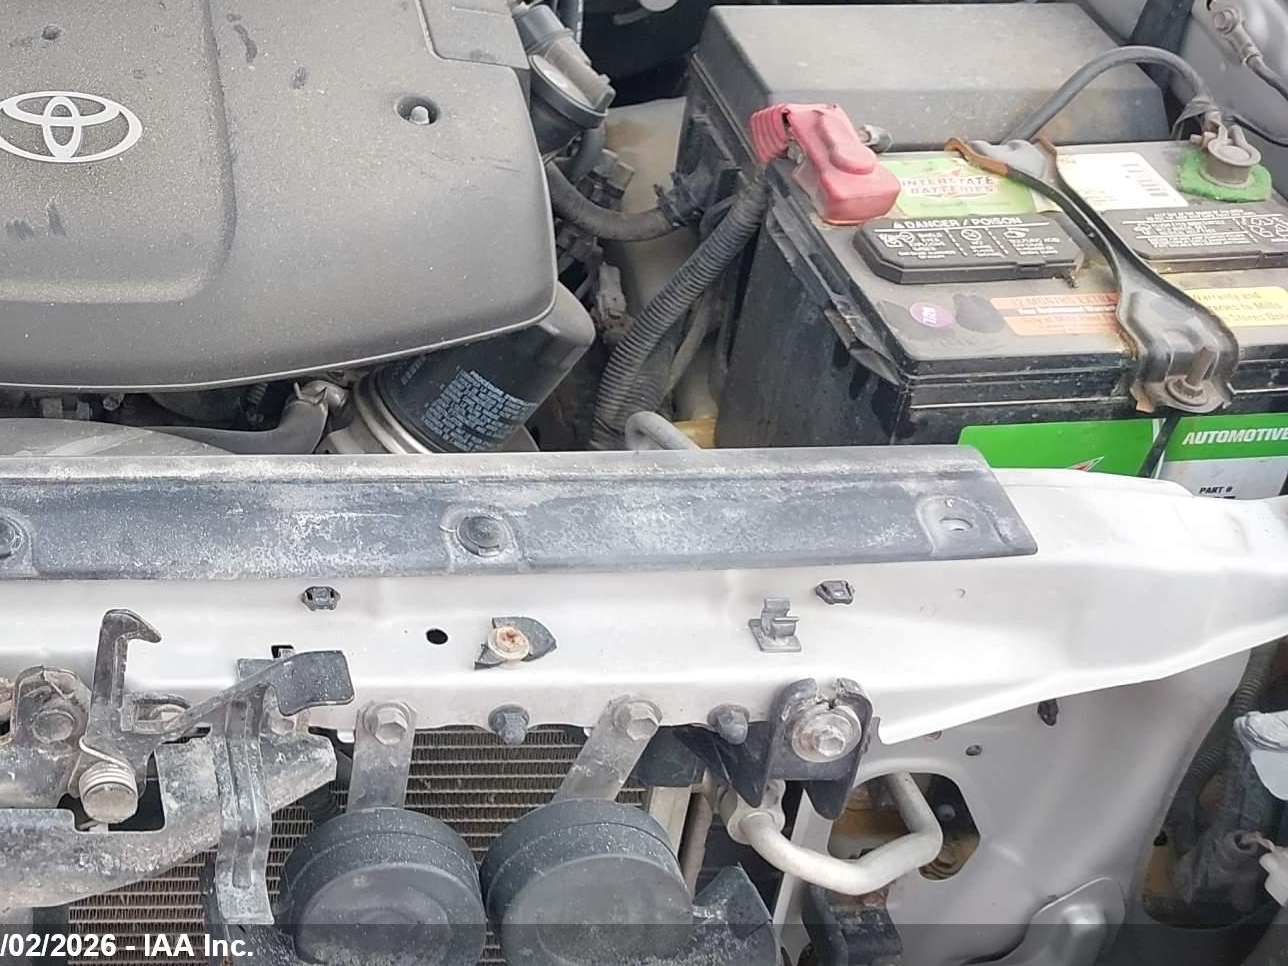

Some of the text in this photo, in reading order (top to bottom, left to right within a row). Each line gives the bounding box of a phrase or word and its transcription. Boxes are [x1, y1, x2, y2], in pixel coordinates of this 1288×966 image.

[904, 219, 960, 229] DANGER
[971, 216, 1023, 226] POISON
[1182, 427, 1288, 446] AUTOMOTIVE
[1199, 486, 1224, 495] PART
